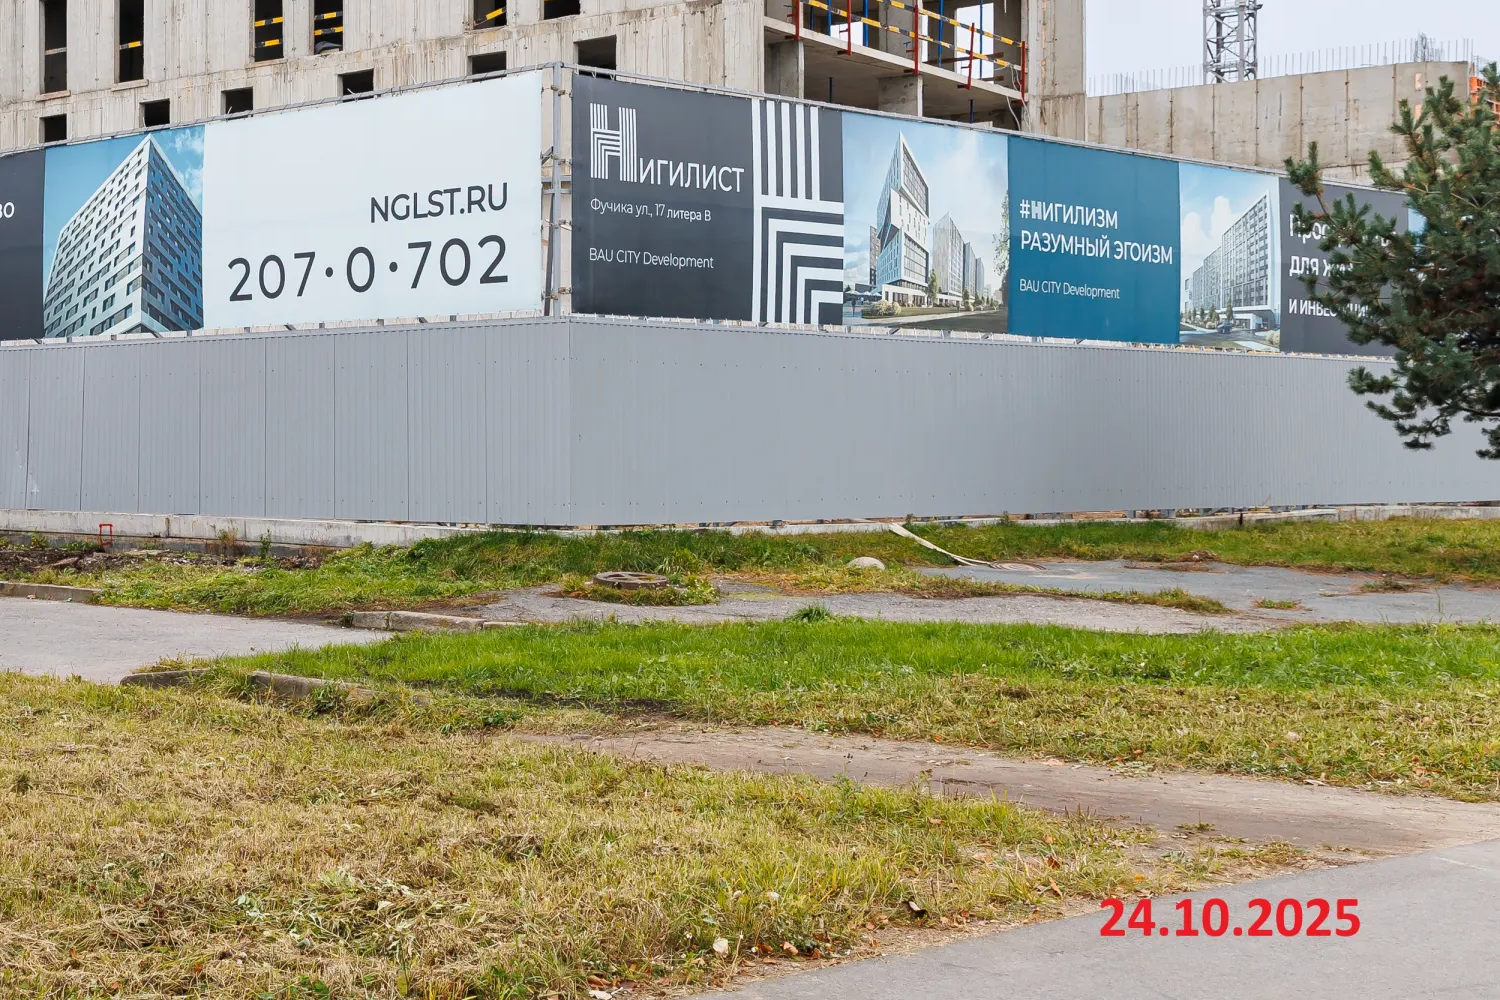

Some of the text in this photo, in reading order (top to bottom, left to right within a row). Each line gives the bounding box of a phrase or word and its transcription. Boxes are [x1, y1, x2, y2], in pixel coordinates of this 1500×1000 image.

[370, 182, 508, 223] NGLST.RU
[590, 197, 712, 222] Фучика ул., 17 литера В
[1019, 199, 1118, 229] #НИГИЛИЗМ
[589, 247, 714, 269] BAU CITY Development
[1021, 229, 1173, 264] РАЗУМНЫЙ ЭГОИЗМ
[1019, 278, 1120, 299] BAU CITY Development
[1288, 299, 1298, 314] И
